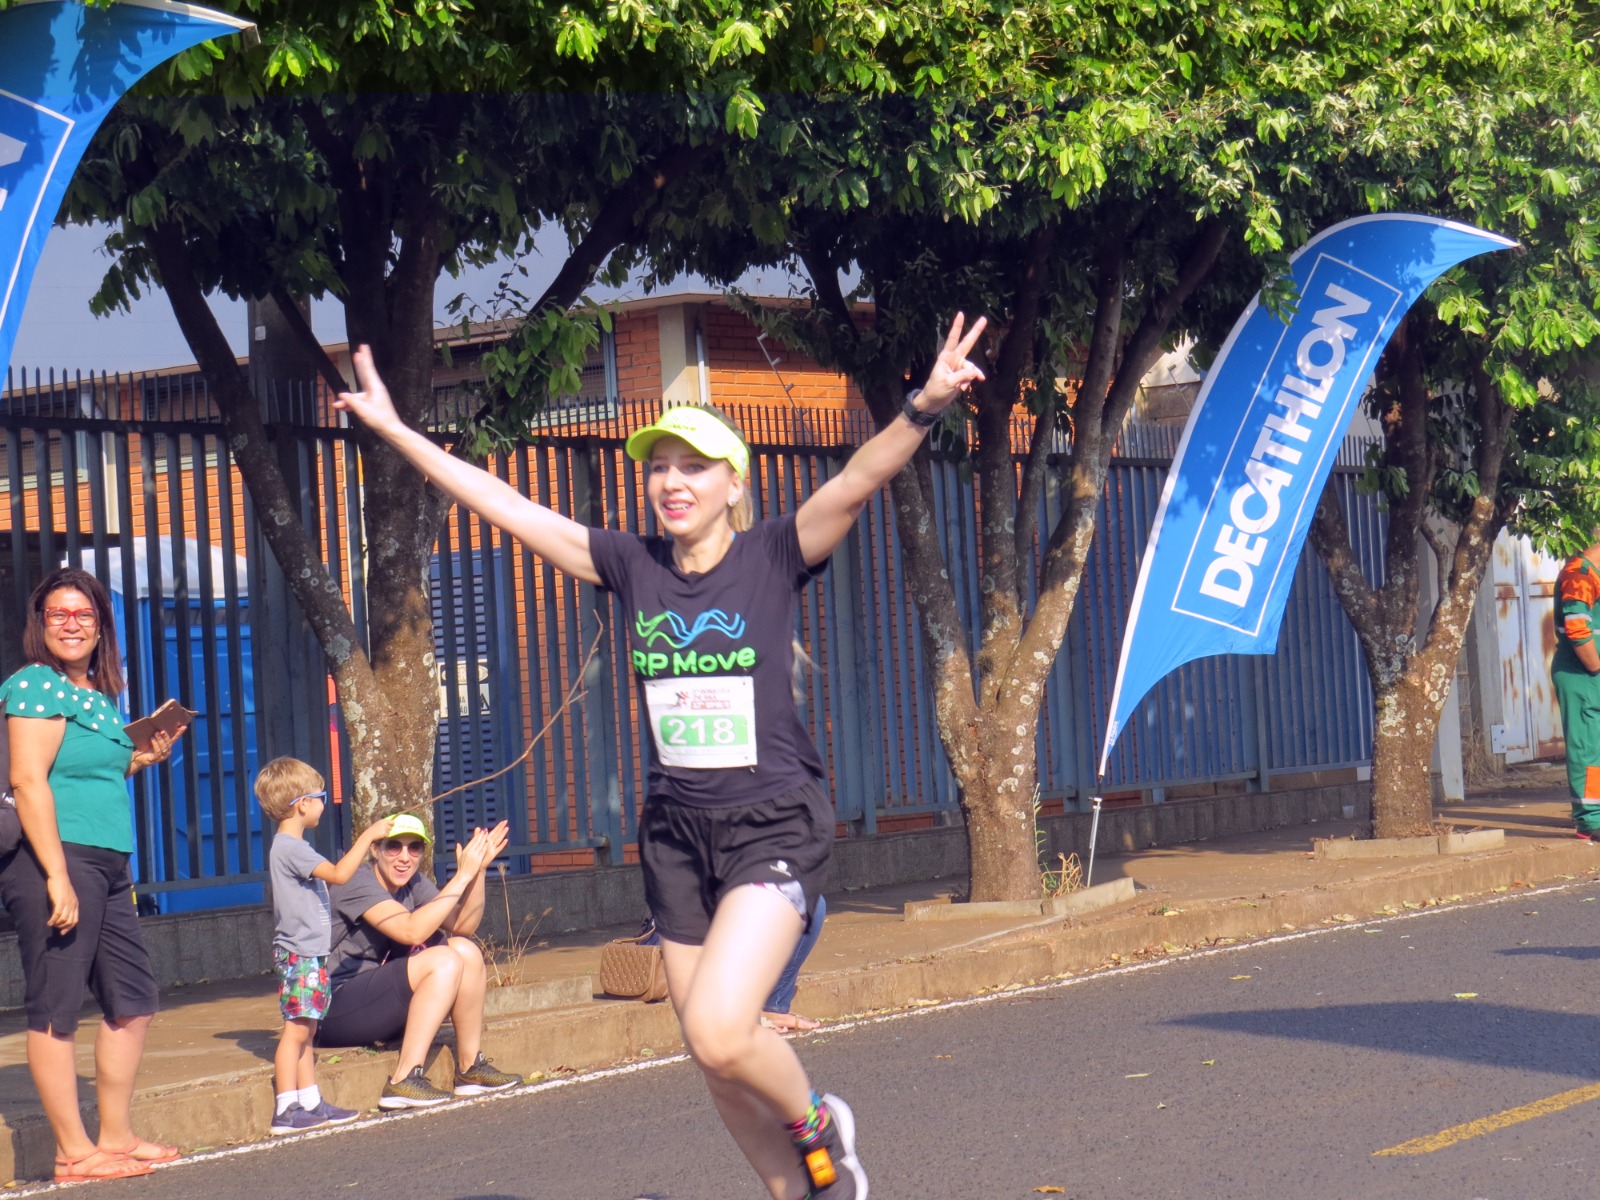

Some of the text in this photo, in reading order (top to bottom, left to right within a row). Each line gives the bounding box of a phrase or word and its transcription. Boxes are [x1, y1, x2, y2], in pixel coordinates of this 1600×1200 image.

[1200, 283, 1372, 608] DECATHLON
[633, 646, 756, 677] RP Move
[667, 717, 736, 745] 218
